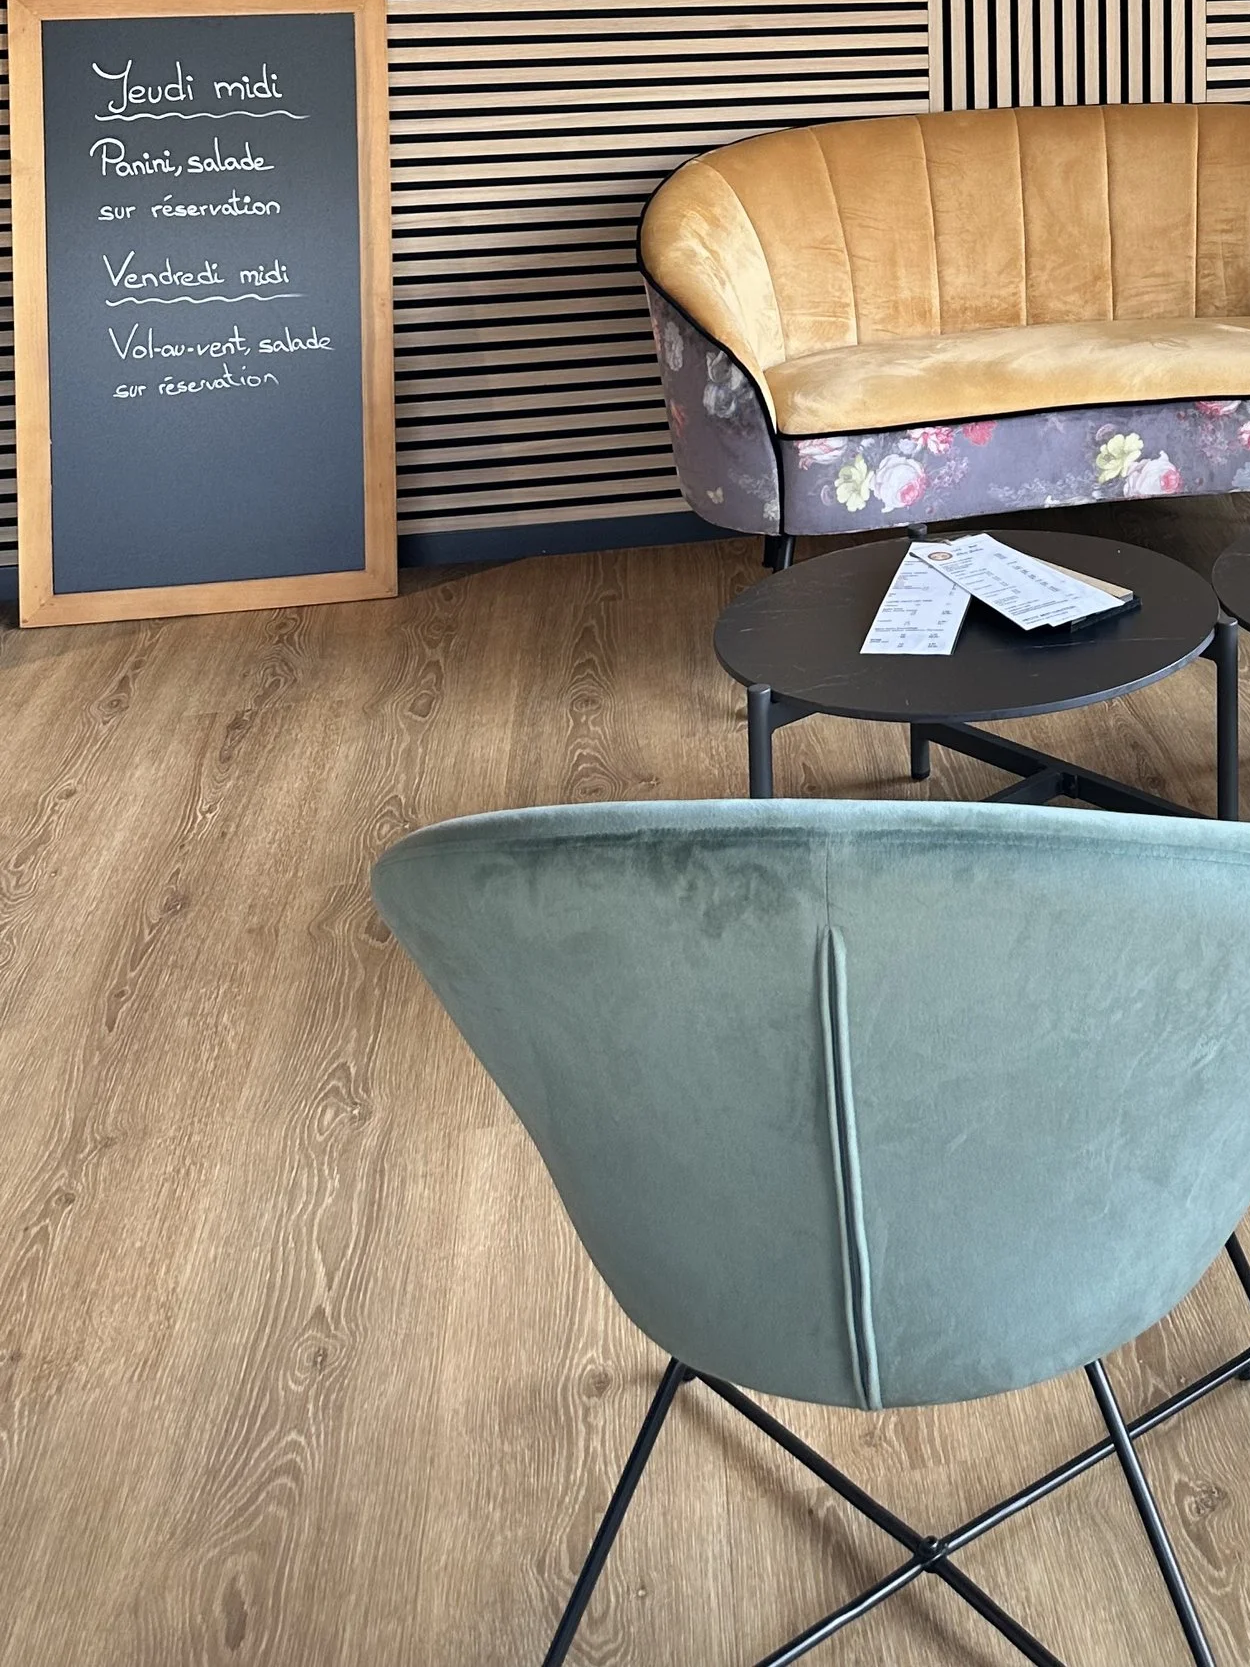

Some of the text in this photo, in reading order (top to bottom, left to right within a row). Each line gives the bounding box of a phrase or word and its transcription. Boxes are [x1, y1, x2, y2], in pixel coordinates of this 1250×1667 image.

[91, 59, 284, 114] Jeudi midi
[89, 136, 275, 178] Panini, salade
[97, 188, 282, 221] sur réservation
[102, 250, 290, 289] Vendredi midi
[108, 322, 336, 360] Vol-au-vent, salade
[112, 362, 281, 399] sur réservation
